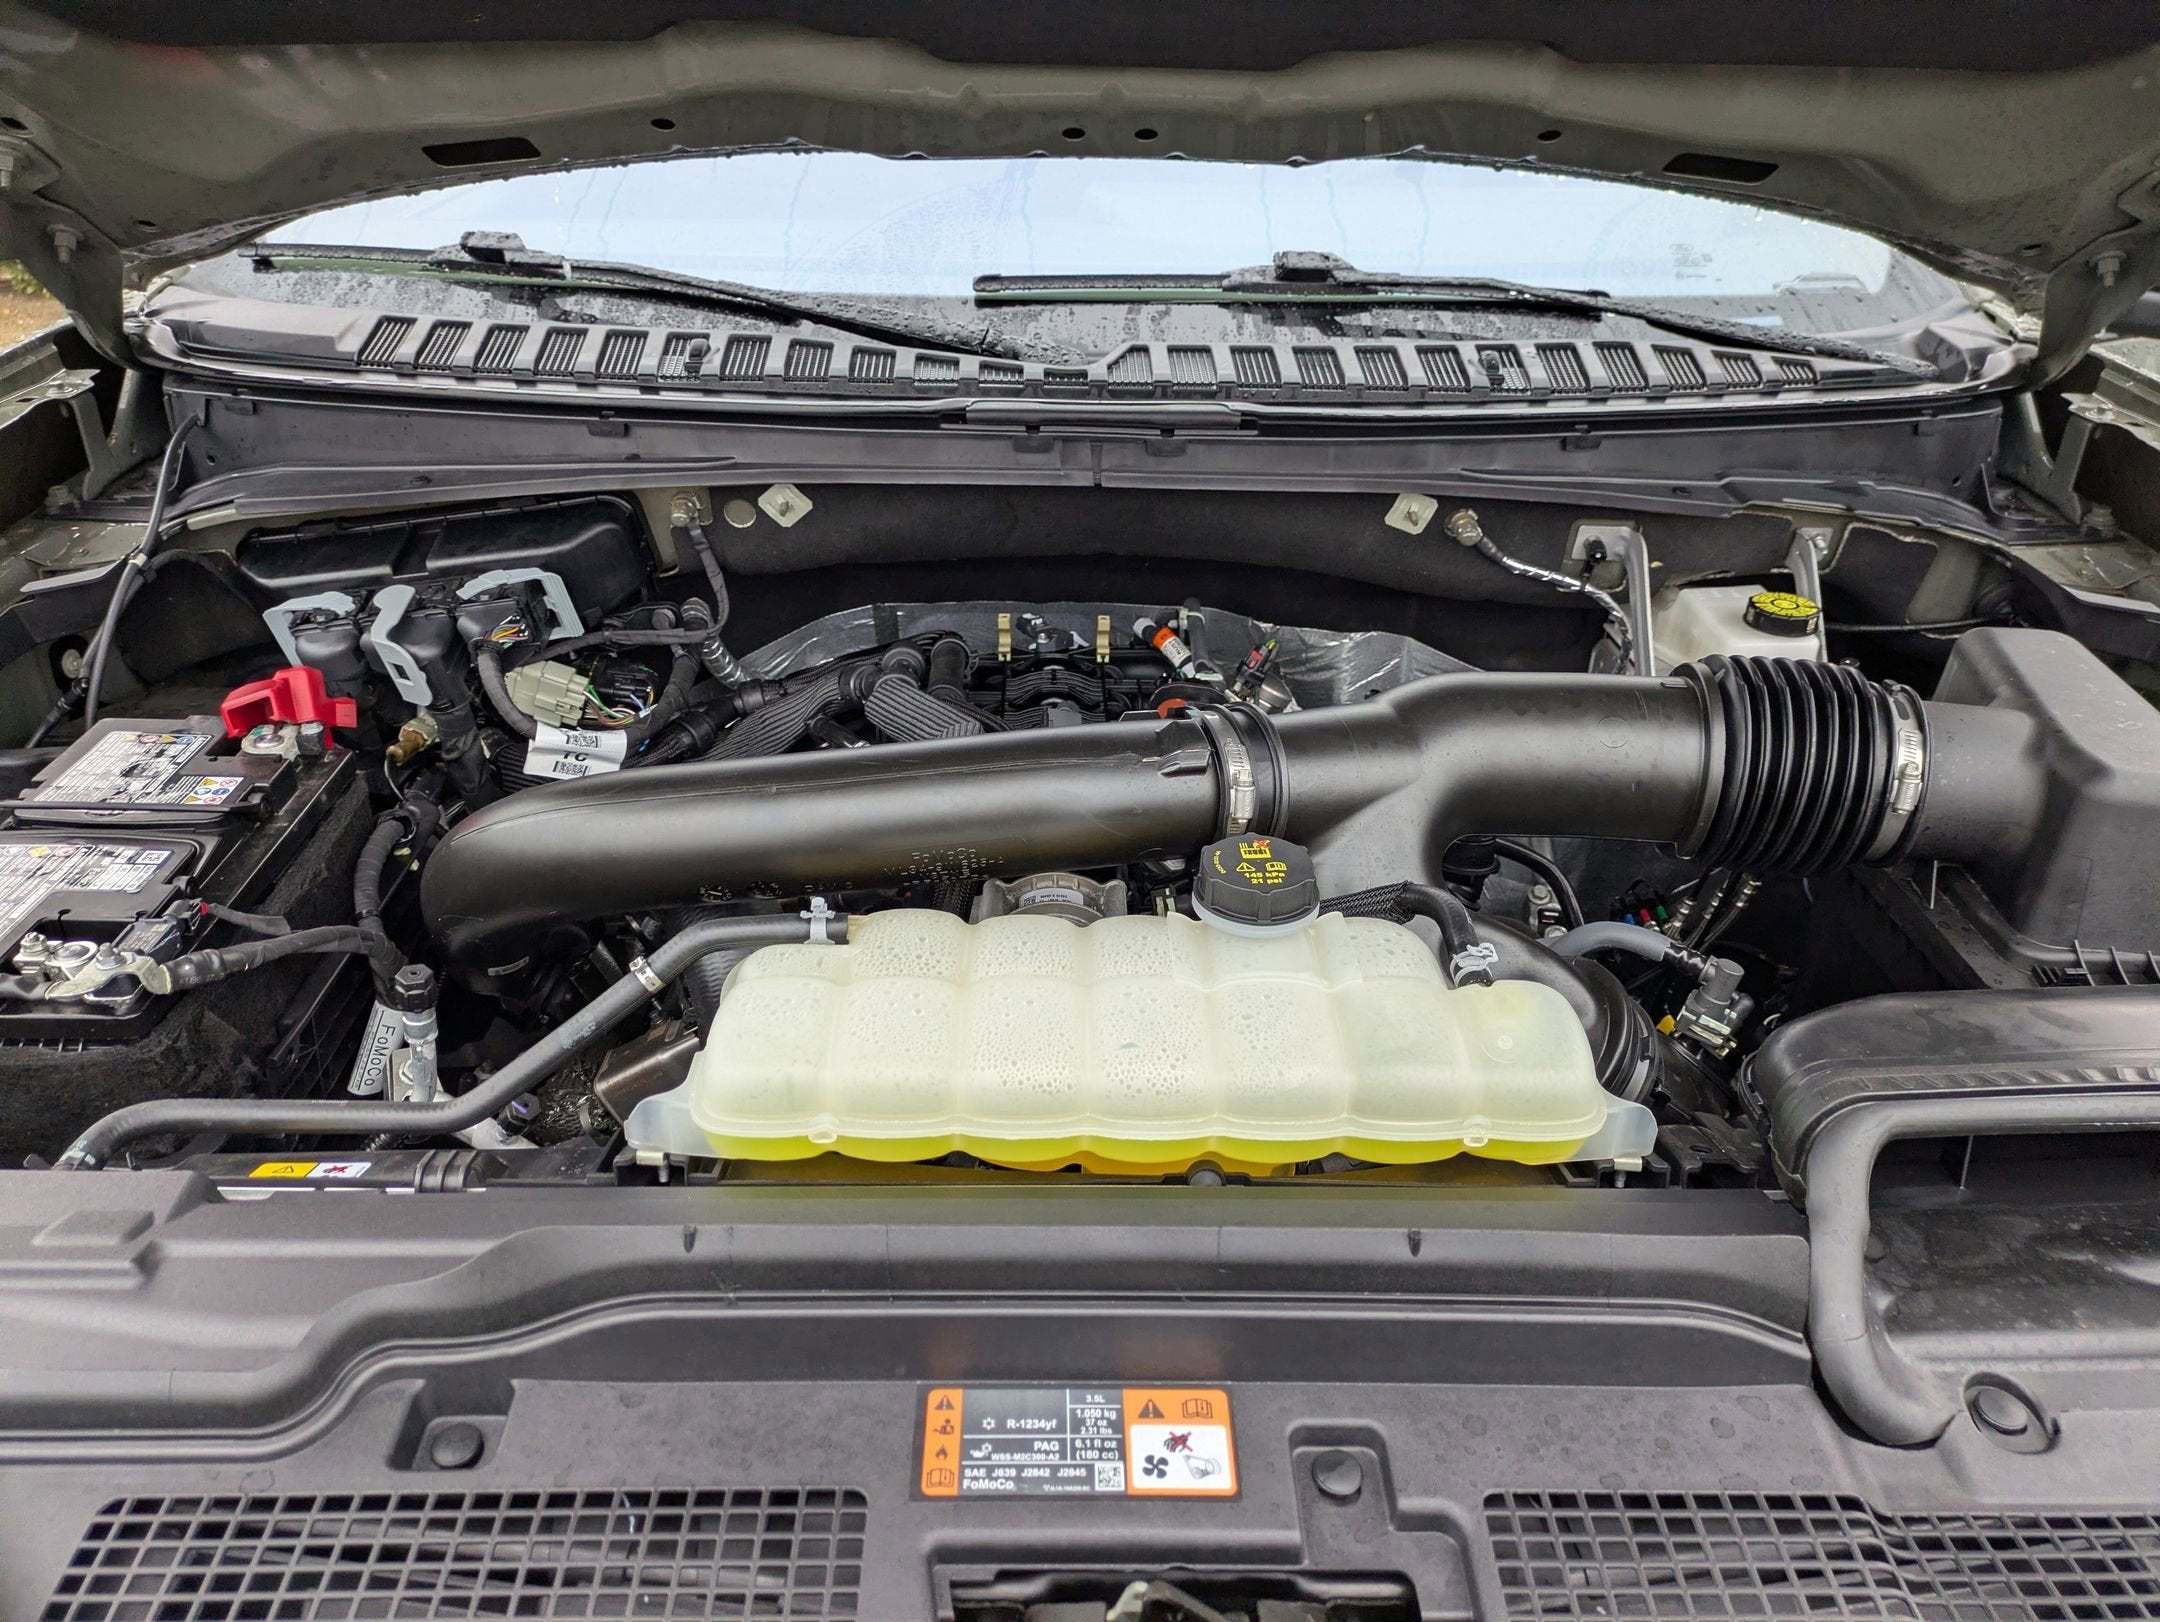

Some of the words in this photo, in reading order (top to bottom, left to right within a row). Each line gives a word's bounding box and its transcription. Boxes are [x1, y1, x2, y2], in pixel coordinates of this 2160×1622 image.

[364, 1024, 396, 1087] FoMoCo
[1086, 1394, 1106, 1403] 3.5L
[1075, 1408, 1102, 1418] 1.050
[1104, 1408, 1116, 1420] kg
[1007, 1418, 1057, 1431] R-1234yf
[1085, 1418, 1095, 1426] 37
[1097, 1419, 1108, 1427] oz
[1080, 1426, 1097, 1435] 2.31
[1100, 1426, 1112, 1435] lbs
[1034, 1440, 1059, 1451] PAG
[1075, 1439, 1091, 1448] 6.1
[1094, 1439, 1101, 1448] fl
[1104, 1440, 1117, 1448] oz
[1076, 1450, 1099, 1460] (180
[1102, 1450, 1119, 1460] cc)
[964, 1468, 987, 1477] SAE
[992, 1467, 1016, 1477] J639
[1021, 1467, 1050, 1477] J2842
[1057, 1467, 1087, 1477] J2845
[963, 1478, 1014, 1490] FoMoCo
